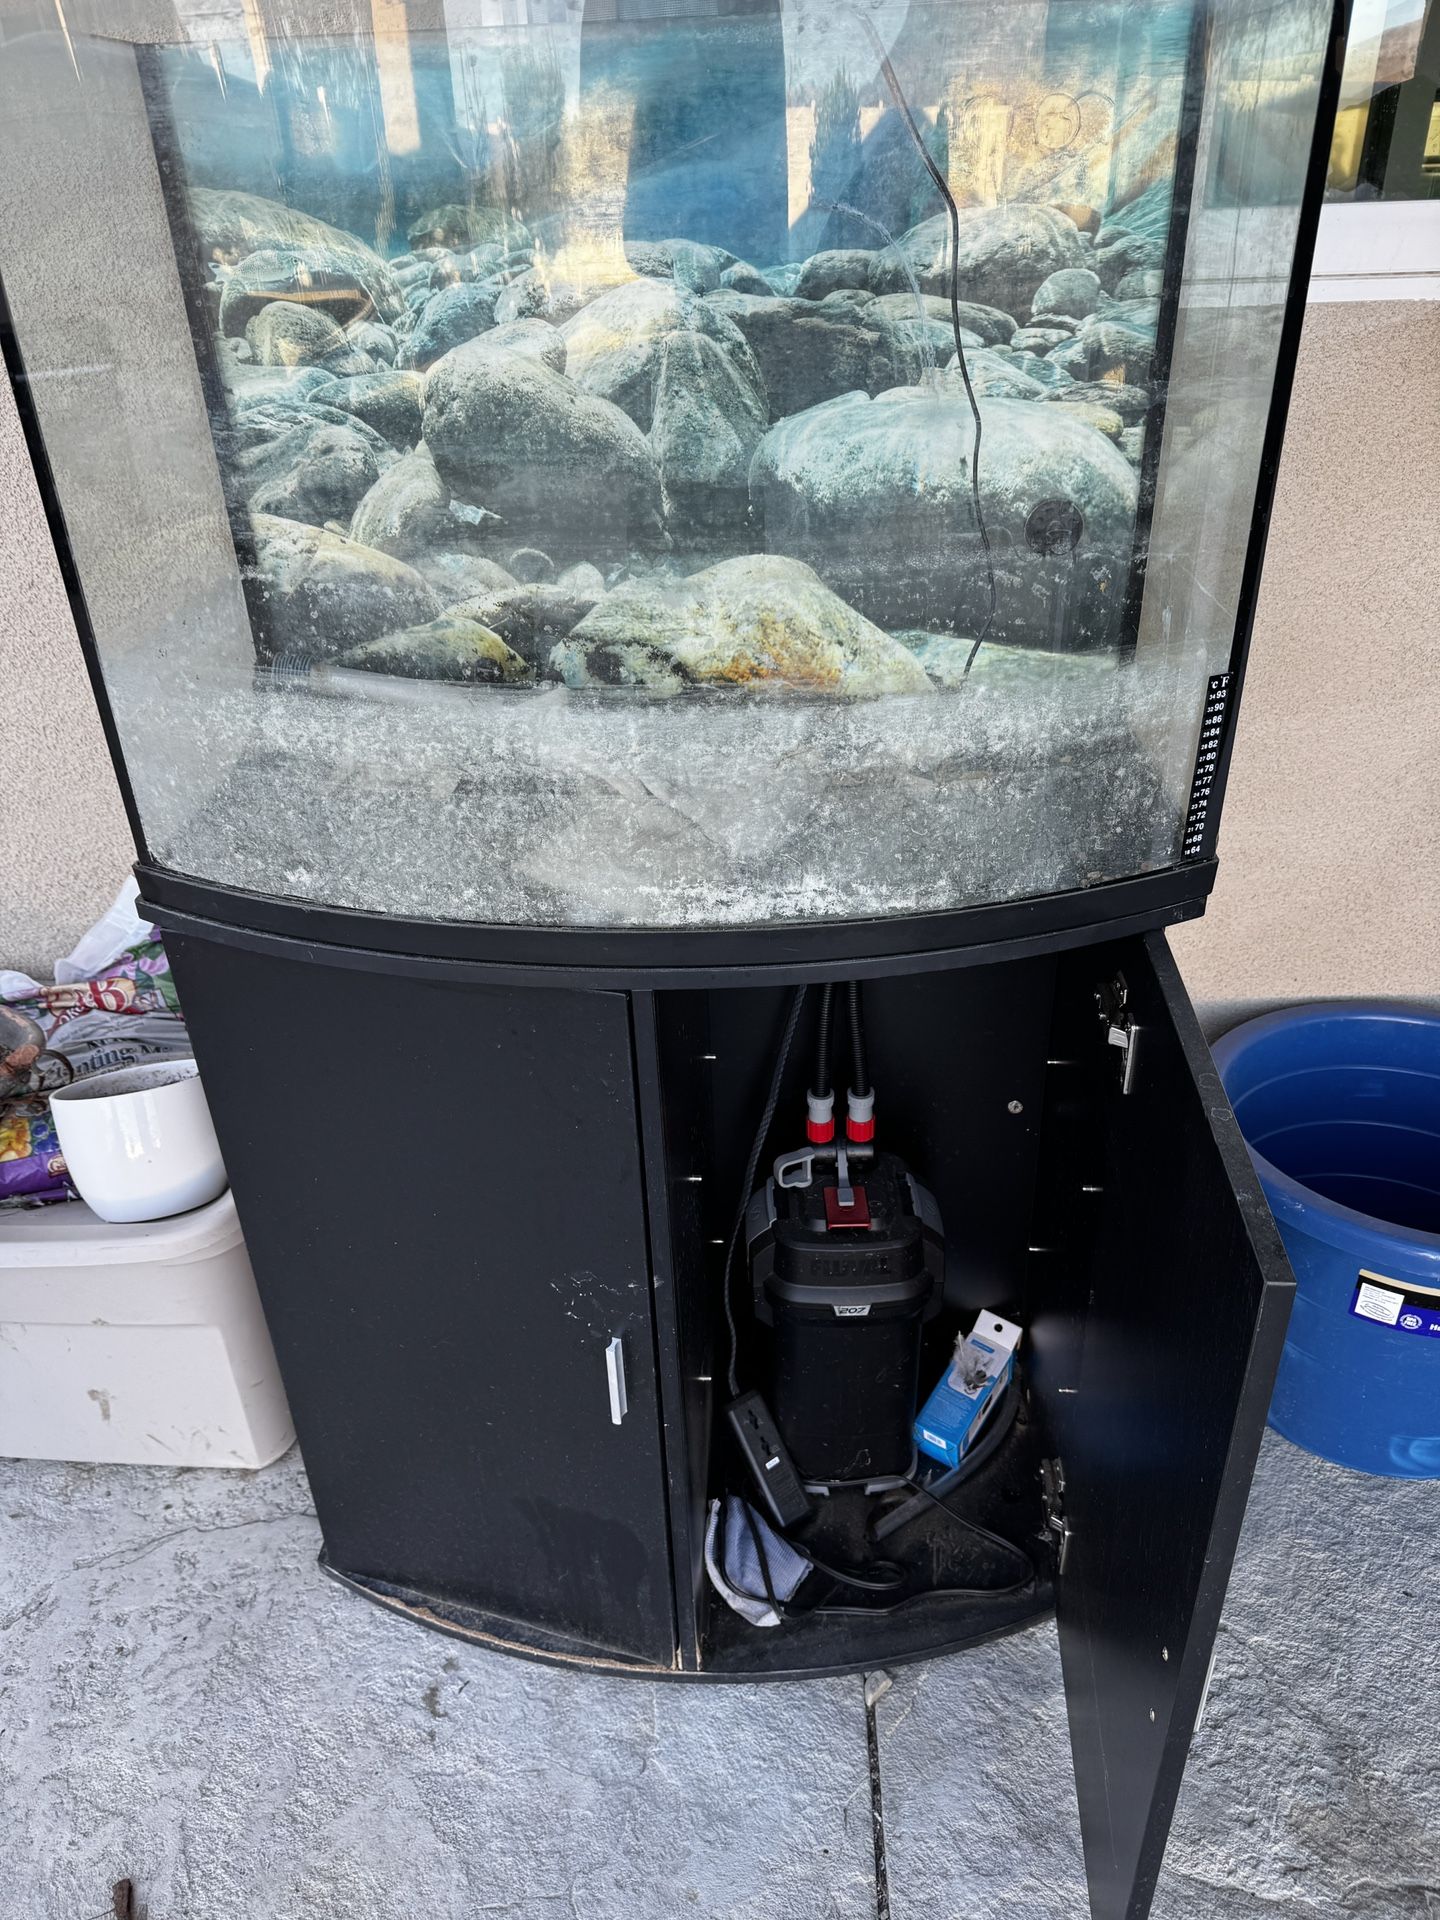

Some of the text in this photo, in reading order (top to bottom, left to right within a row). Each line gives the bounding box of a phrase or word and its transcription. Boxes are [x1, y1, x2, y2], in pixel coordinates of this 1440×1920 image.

[1216, 690, 1226, 698] 93
[1214, 703, 1224, 711] 90
[1212, 715, 1222, 723] 86
[1210, 728, 1220, 736] 84
[1208, 740, 1218, 748] 82
[1206, 752, 1216, 760] 80
[1204, 764, 1214, 772] 78
[1203, 776, 1212, 784] 77
[1201, 788, 1210, 796] 76
[1198, 800, 1207, 808] 74
[1197, 811, 1206, 820] 72
[1195, 823, 1204, 831] 70
[1193, 834, 1202, 842] 68
[1191, 845, 1200, 854] 64
[839, 1307, 867, 1315] 207
